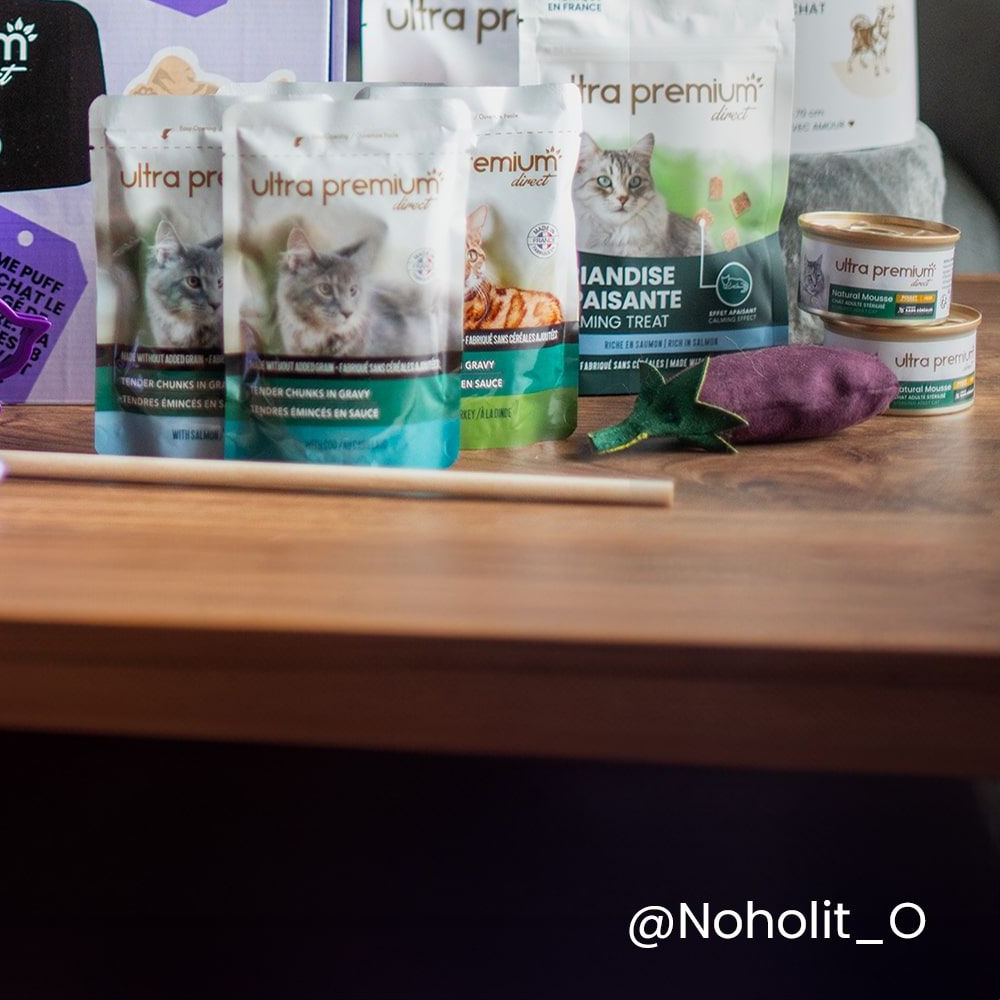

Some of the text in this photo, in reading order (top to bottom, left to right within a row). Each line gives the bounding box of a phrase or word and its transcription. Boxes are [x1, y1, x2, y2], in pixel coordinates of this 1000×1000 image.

[477, 7, 519, 44] pr
[631, 78, 758, 115] premium
[711, 105, 756, 121] direct
[472, 152, 557, 172] emium
[121, 163, 180, 188] ultra
[511, 173, 557, 188] direct
[252, 171, 438, 206] ultra premium
[393, 198, 437, 211] direct
[835, 258, 868, 275] ultra
[872, 264, 934, 280] premium
[18, 264, 64, 295] PUFF
[832, 289, 860, 299] Natural
[862, 294, 893, 302] Mousse
[43, 296, 65, 316] LE
[626, 315, 669, 328] TREAT
[494, 335, 509, 344] SANS
[465, 361, 494, 370] GRAVY
[614, 361, 631, 369] SANS
[896, 353, 929, 367] ultra
[121, 377, 154, 388] TENDER
[156, 380, 194, 389] CHUNKS
[461, 379, 502, 388] EN SAUCE
[250, 386, 370, 399] TENDER CHUNKS IN GRAVY
[122, 395, 159, 407] TENDRES
[162, 398, 202, 408] ÉMINCÉS
[250, 405, 379, 418] TENDRES ÉMINCÉS EN SAUCE
[173, 430, 219, 440] WITH SALMON
